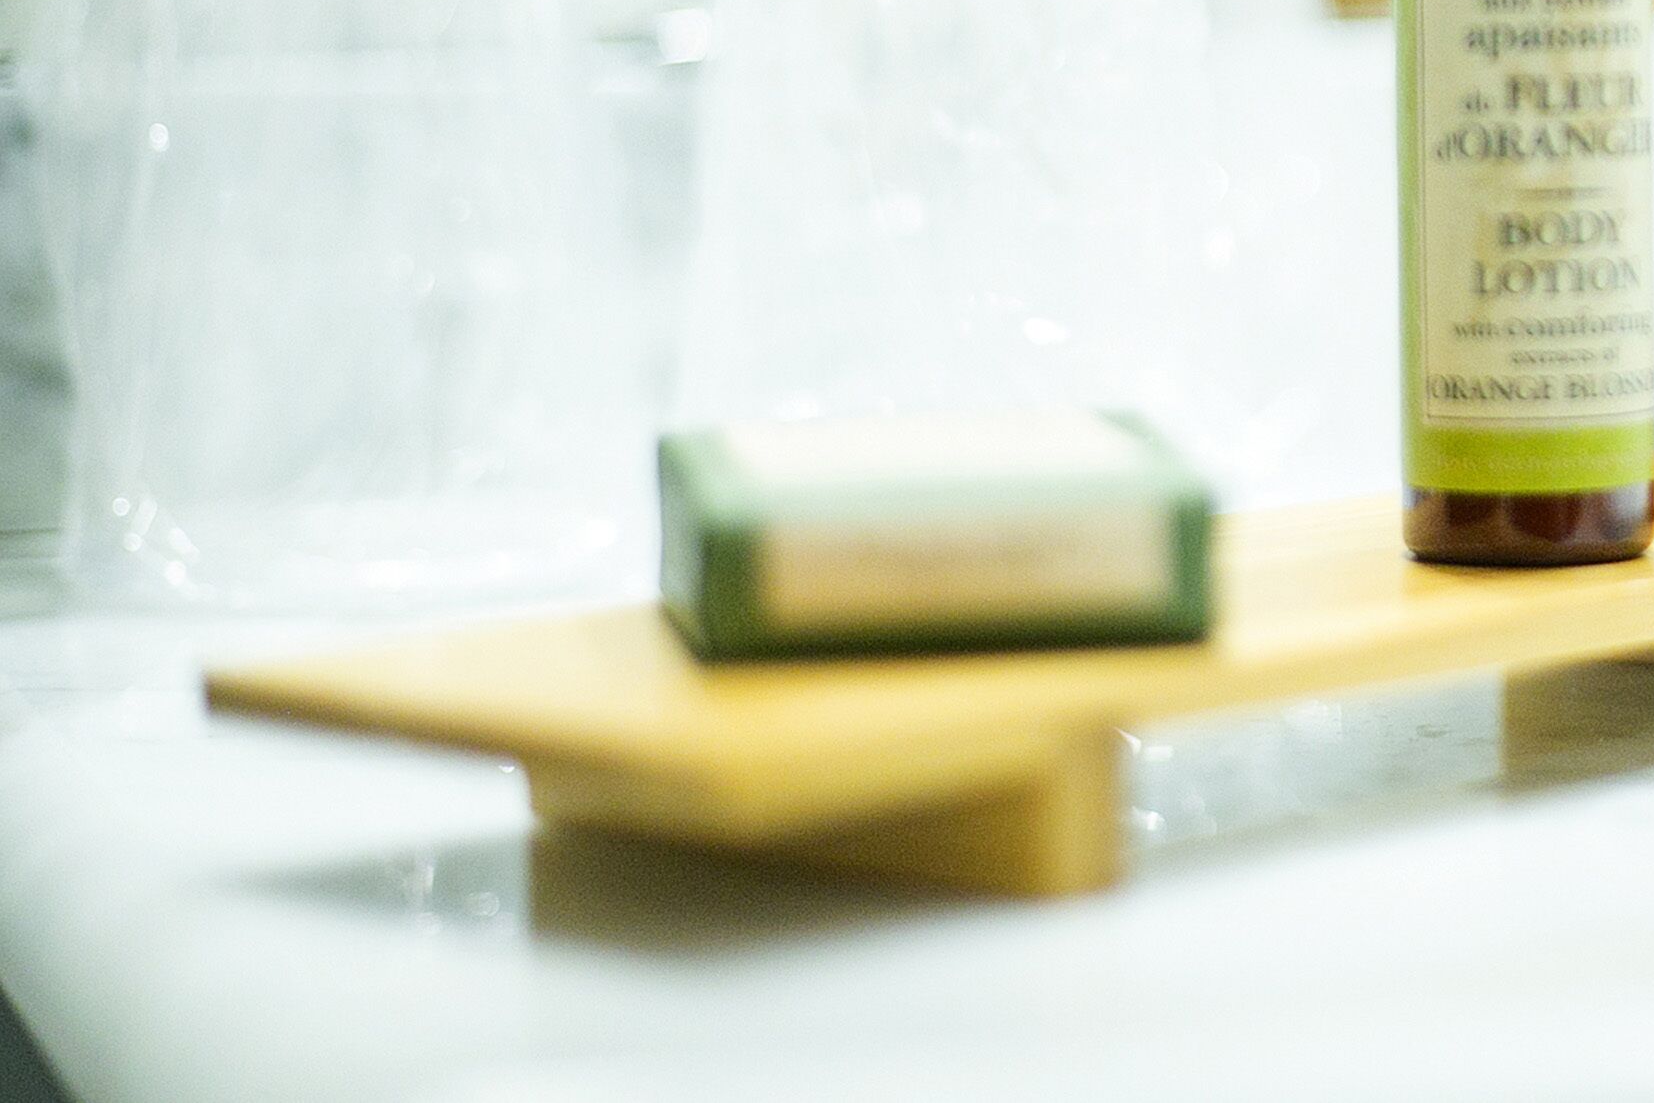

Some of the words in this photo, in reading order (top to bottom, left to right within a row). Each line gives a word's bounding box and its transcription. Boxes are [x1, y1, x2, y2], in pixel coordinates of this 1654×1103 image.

[1504, 71, 1643, 112] FLEUR
[1497, 209, 1624, 248] BODY
[1471, 257, 1641, 297] LOTION
